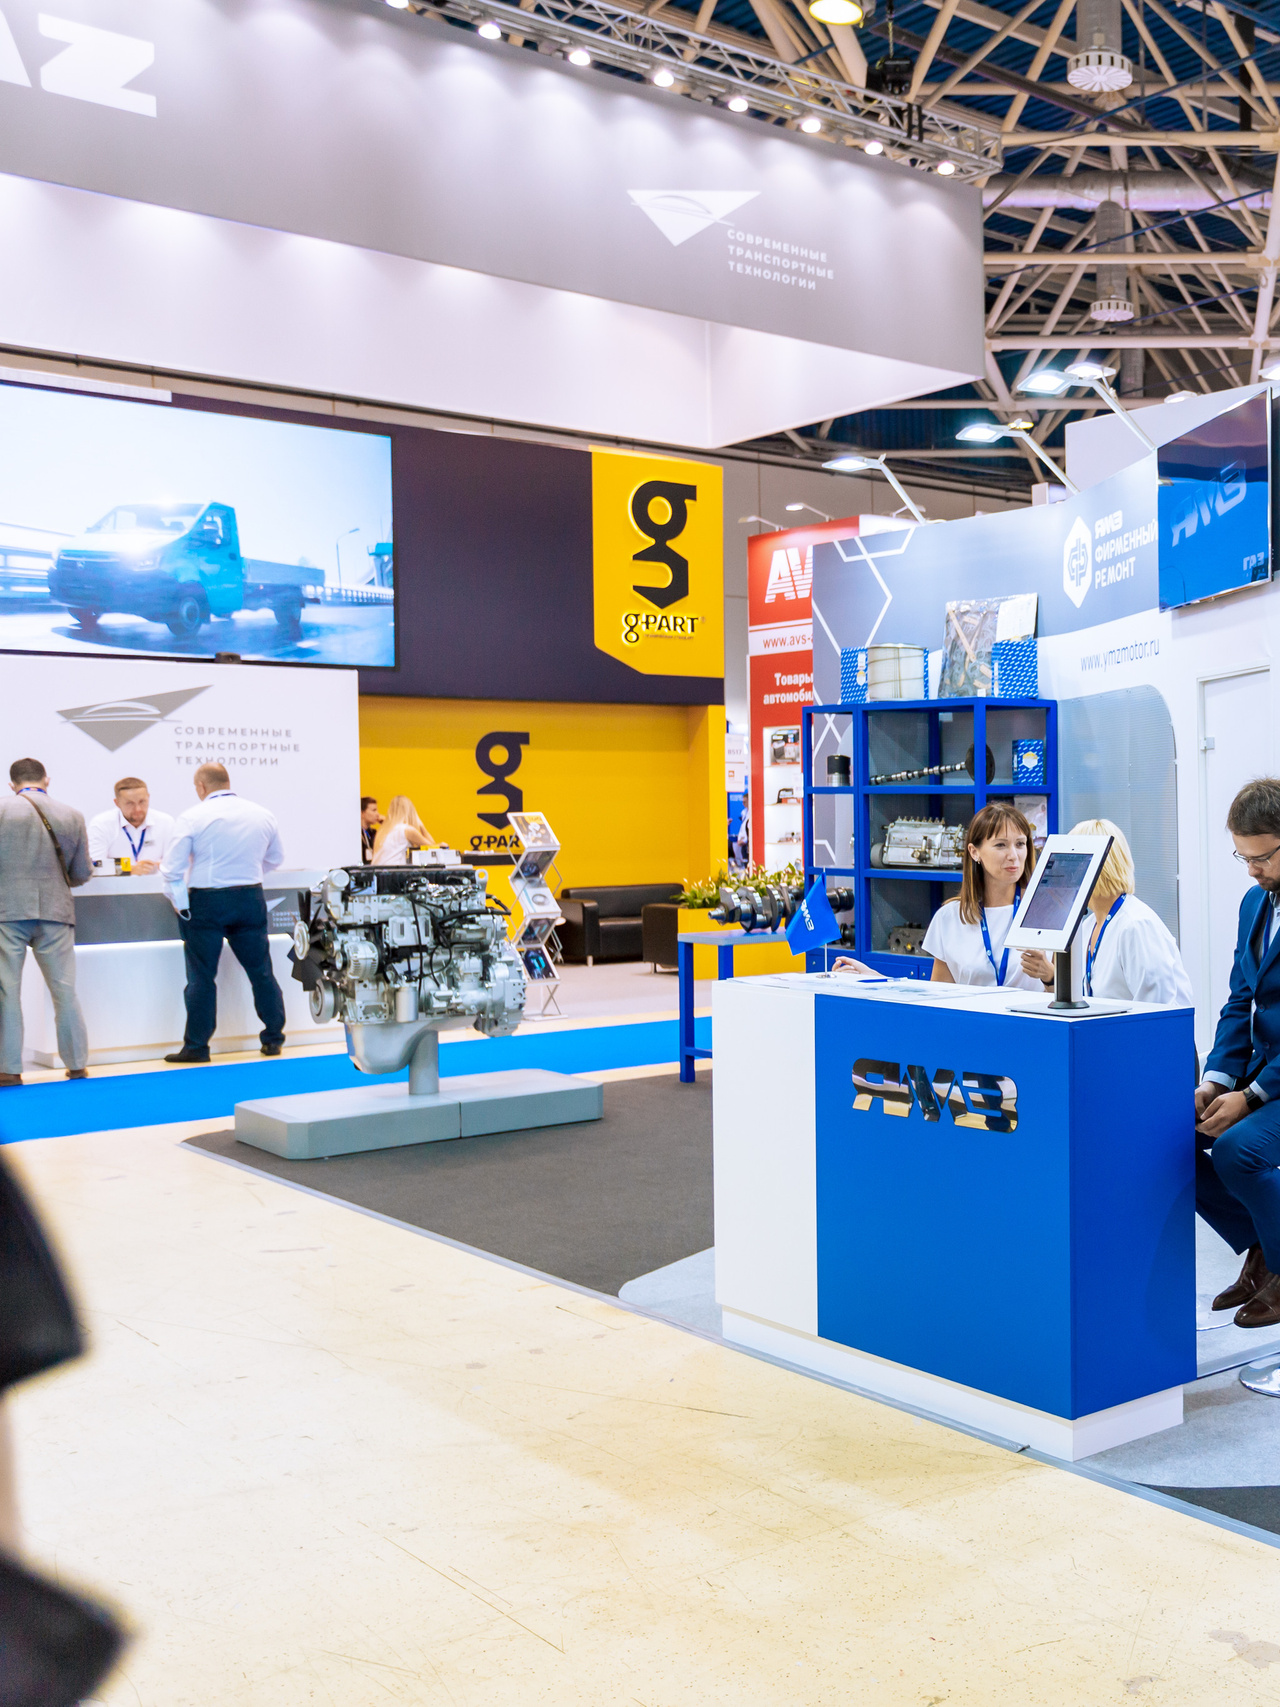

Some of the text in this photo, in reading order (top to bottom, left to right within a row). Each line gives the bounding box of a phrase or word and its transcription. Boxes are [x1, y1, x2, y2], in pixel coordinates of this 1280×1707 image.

[727, 229, 828, 263] СОВРЕМЕННЫЕ
[728, 245, 834, 280] ТРАНСПОРТНЫЕ
[728, 261, 816, 290] ТЕХНОЛОГИИ
[1094, 518, 1159, 563] ФИРМЕННЫЙ
[1094, 556, 1136, 590] РЕМОНТ
[1080, 639, 1160, 672] www.ymzmotor.ru
[774, 672, 813, 687] Товары
[174, 726, 292, 737] СОВРЕМЕННЫЕ
[175, 741, 300, 752] ТРАНСПОРТНЫЕ
[175, 756, 279, 766] ТЕХНОЛОГИИ
[852, 1058, 1018, 1134] ЯМЗ
